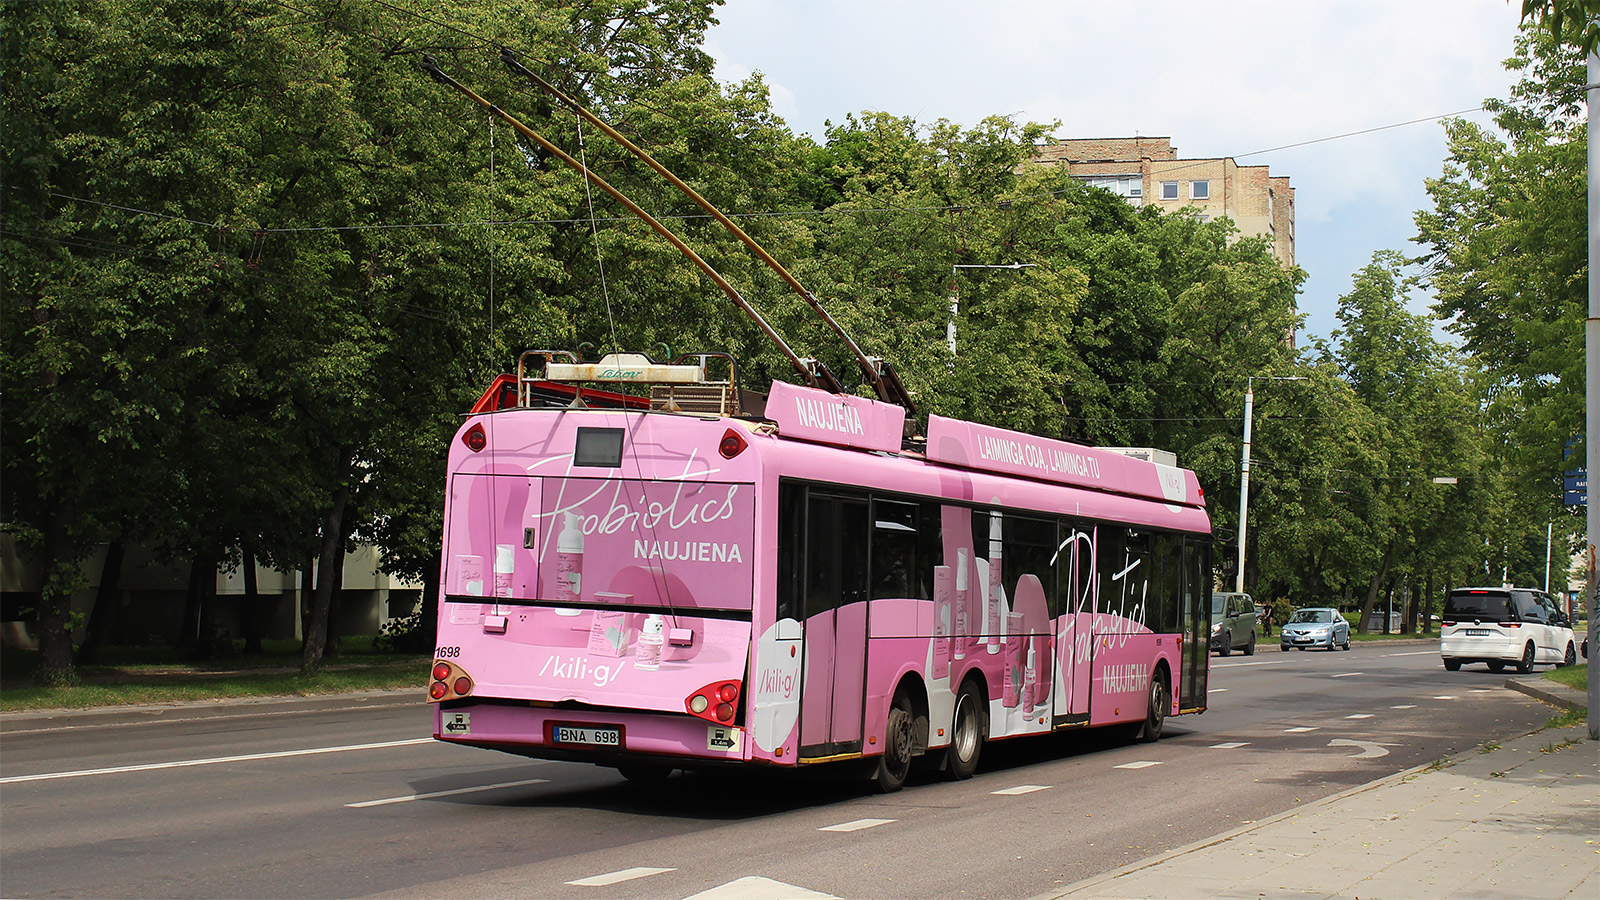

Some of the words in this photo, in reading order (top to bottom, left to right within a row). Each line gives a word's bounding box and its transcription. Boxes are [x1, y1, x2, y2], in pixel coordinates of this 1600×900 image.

[795, 396, 864, 436] NAUJIENA
[977, 434, 1025, 465] LAIMINGA
[1025, 444, 1049, 475] ODA,
[1049, 449, 1088, 477] LAIMINGA
[1087, 458, 1101, 480] TU
[527, 448, 740, 563] Probiotics
[634, 539, 742, 563] NAUJIENA
[435, 646, 461, 658] 1698
[1102, 663, 1148, 694] NAUJIENA
[560, 729, 586, 742] BNA
[594, 730, 617, 744] 698
